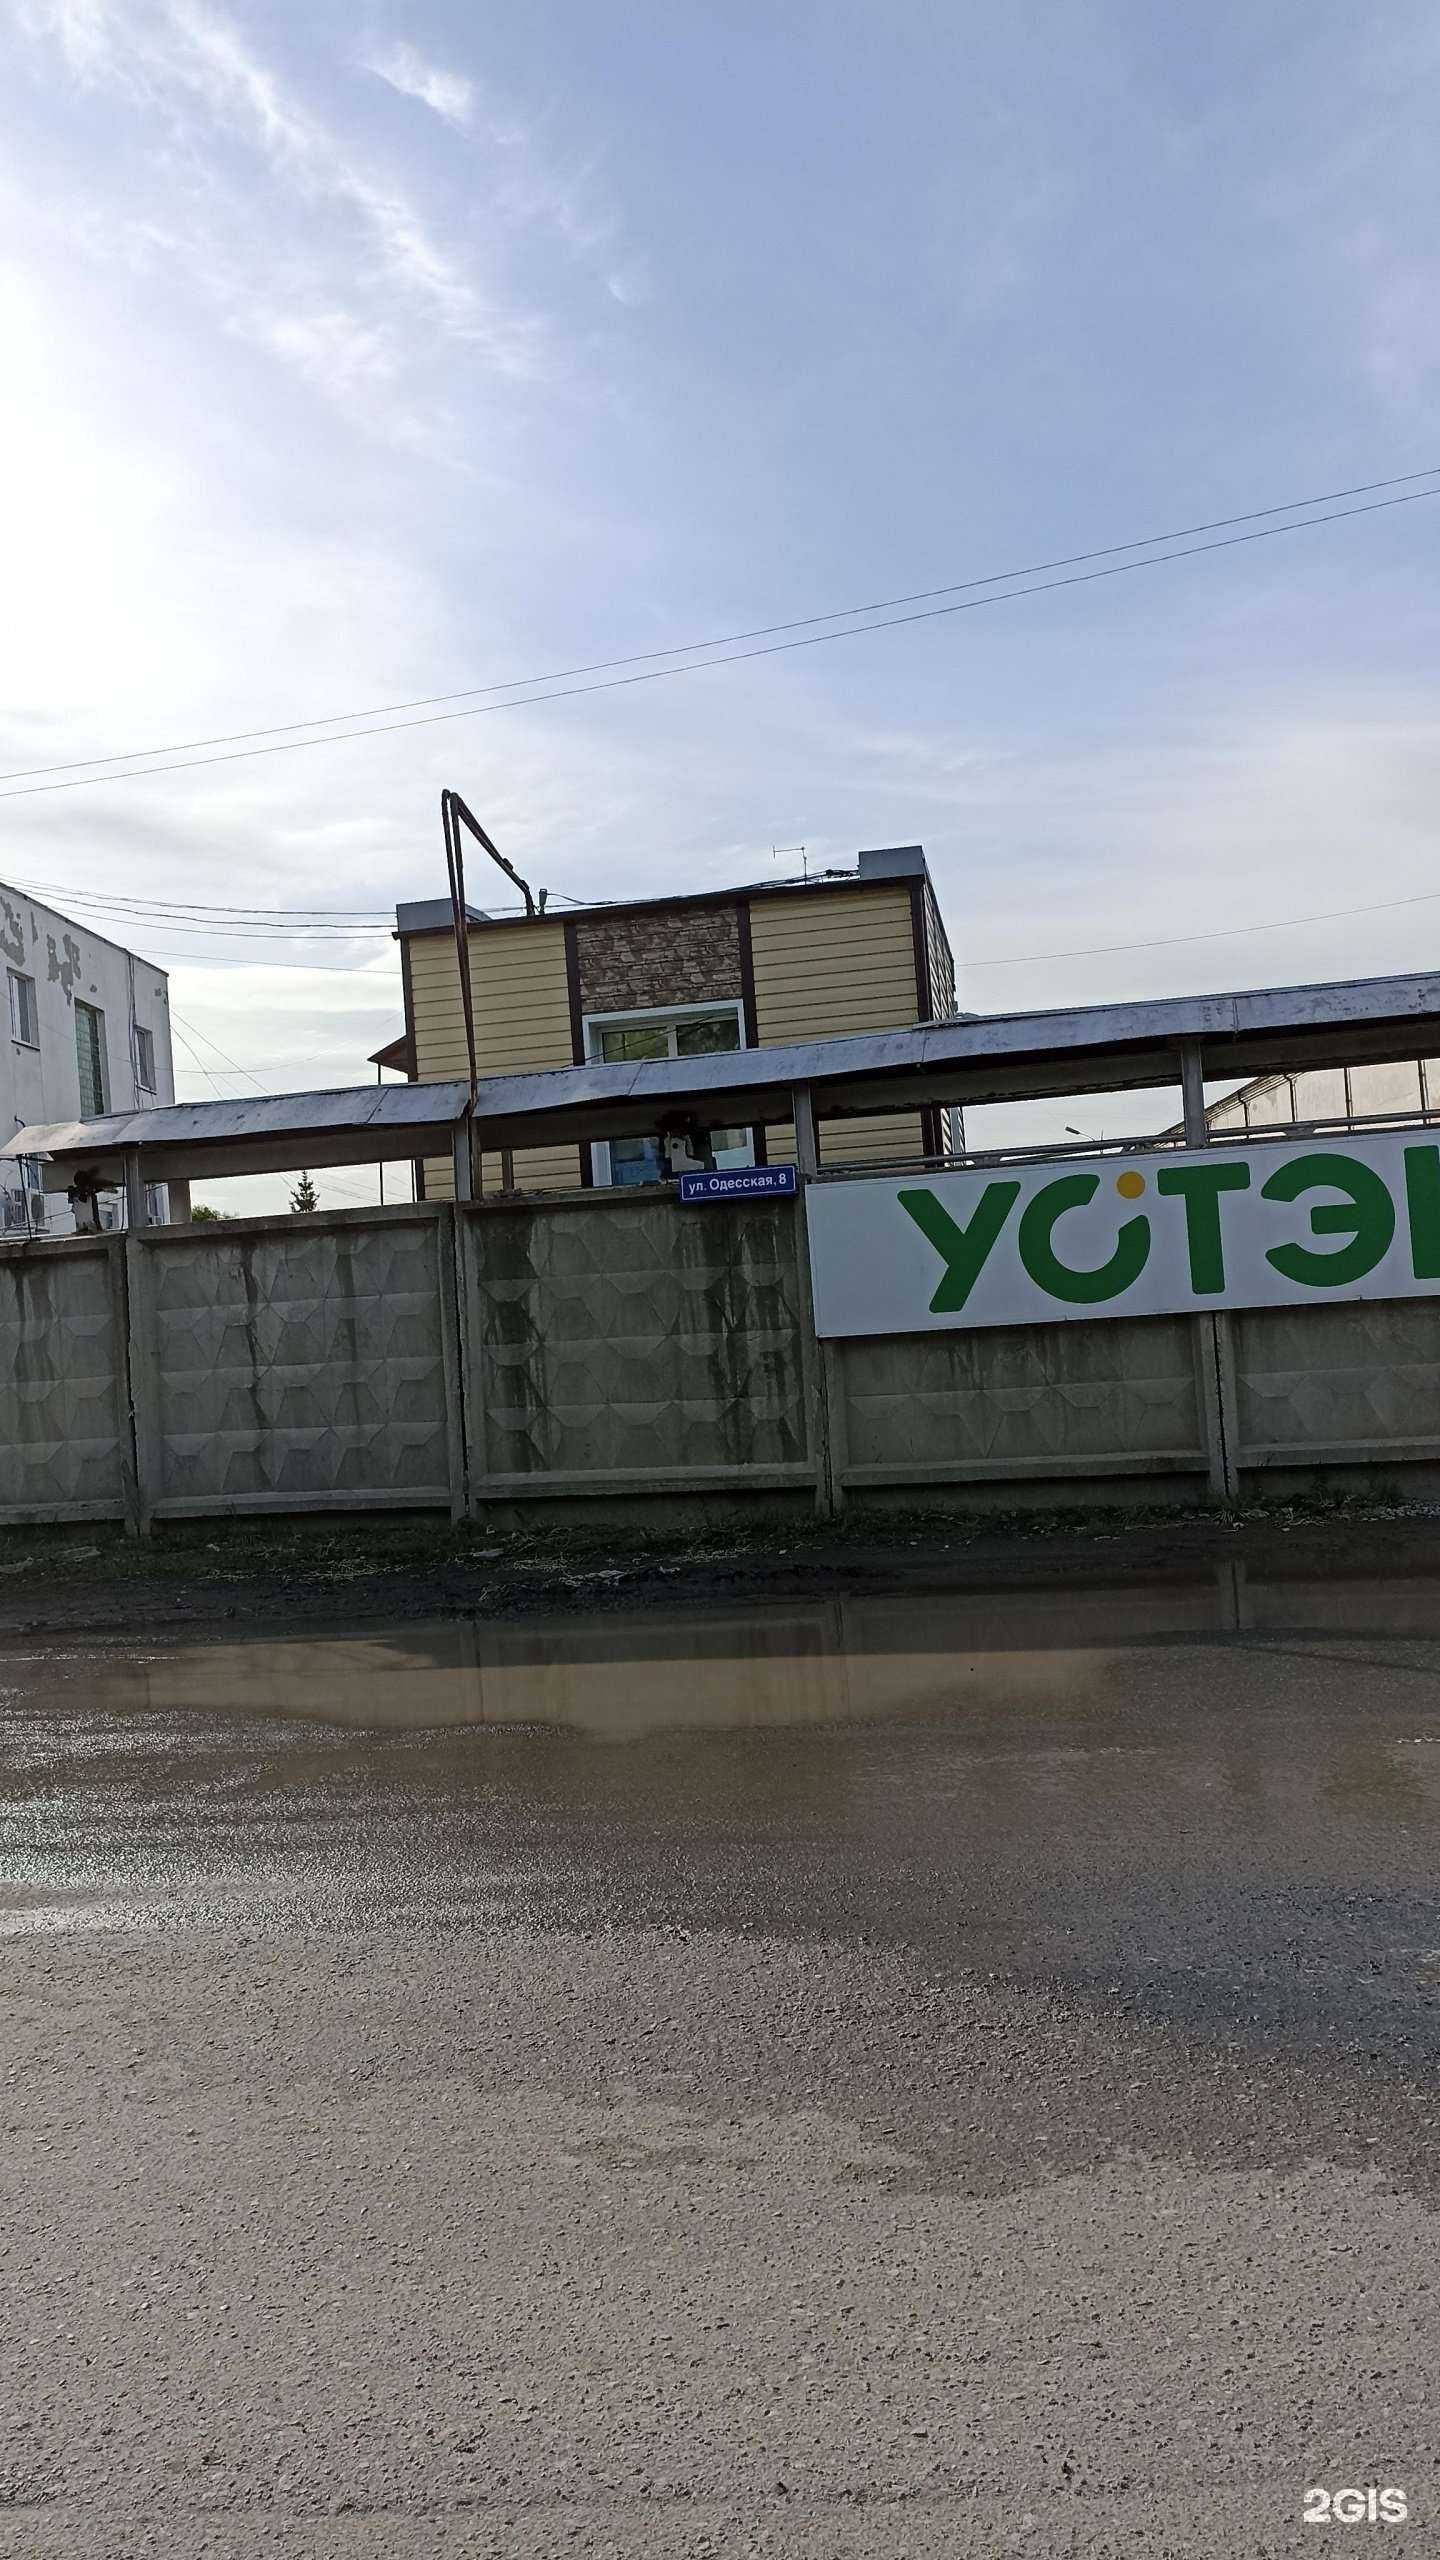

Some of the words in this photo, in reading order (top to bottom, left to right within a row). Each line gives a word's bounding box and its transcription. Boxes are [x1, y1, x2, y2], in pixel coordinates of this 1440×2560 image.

[688, 1182, 707, 1195] ул.
[709, 1176, 777, 1191] Одесская,
[778, 1173, 787, 1185] 8
